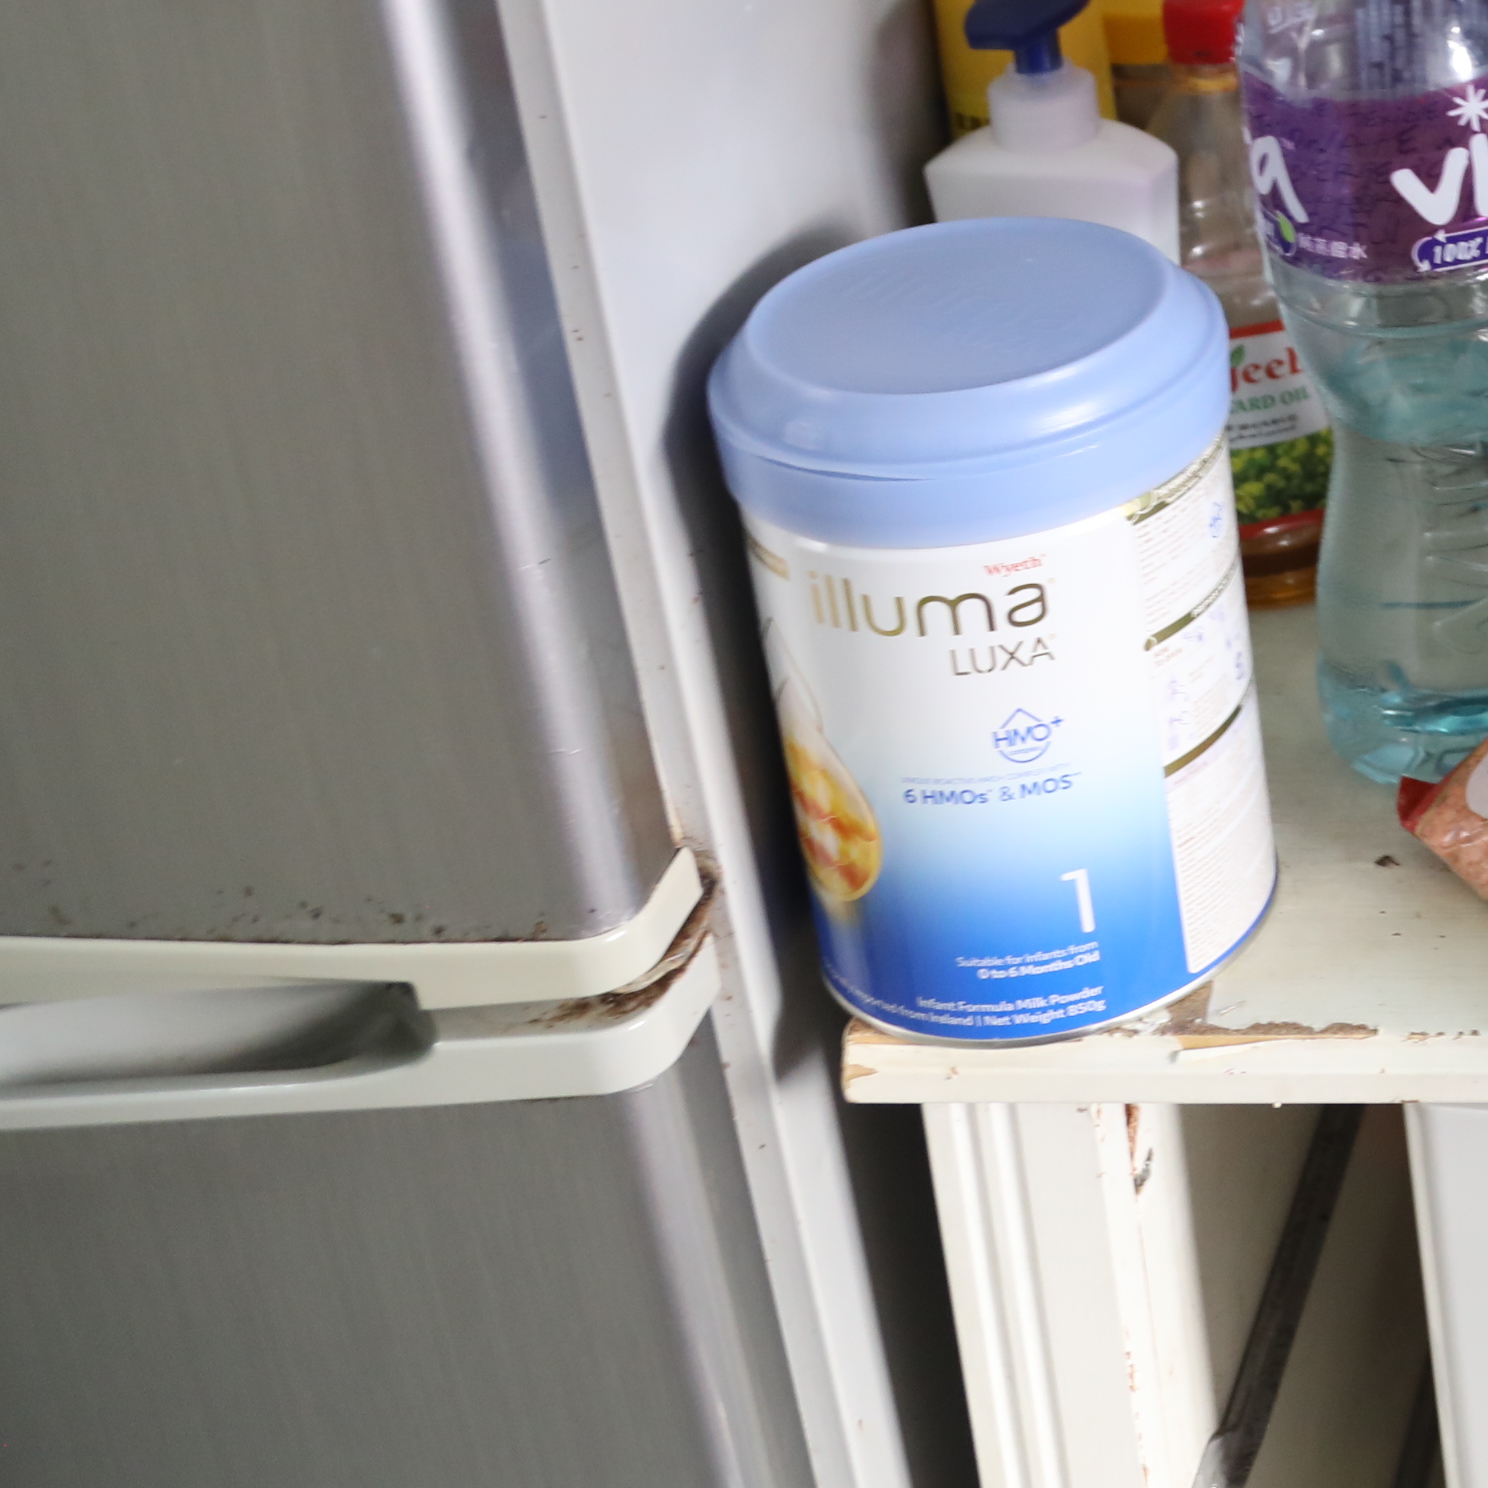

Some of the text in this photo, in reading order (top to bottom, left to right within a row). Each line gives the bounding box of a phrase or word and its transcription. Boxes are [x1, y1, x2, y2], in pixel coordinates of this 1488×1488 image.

[984, 555, 1044, 577] Wyeth
[807, 570, 1049, 638] illuma
[950, 637, 1055, 676] LUXA
[904, 787, 918, 804] 6
[999, 785, 1014, 802] &
[1060, 868, 1096, 934] 1
[955, 955, 1004, 968] Suitable
[1005, 954, 1024, 965] for
[1069, 940, 1099, 954] from
[993, 968, 1006, 979] to
[1008, 966, 1018, 978] 6
[1018, 960, 1075, 977] Months
[1075, 951, 1101, 966] Old
[916, 984, 1104, 1013] Infant Formula Milk Powder
[983, 1012, 1011, 1026] Net
[1012, 1006, 1067, 1026] Weight
[1066, 998, 1107, 1018] 850g
